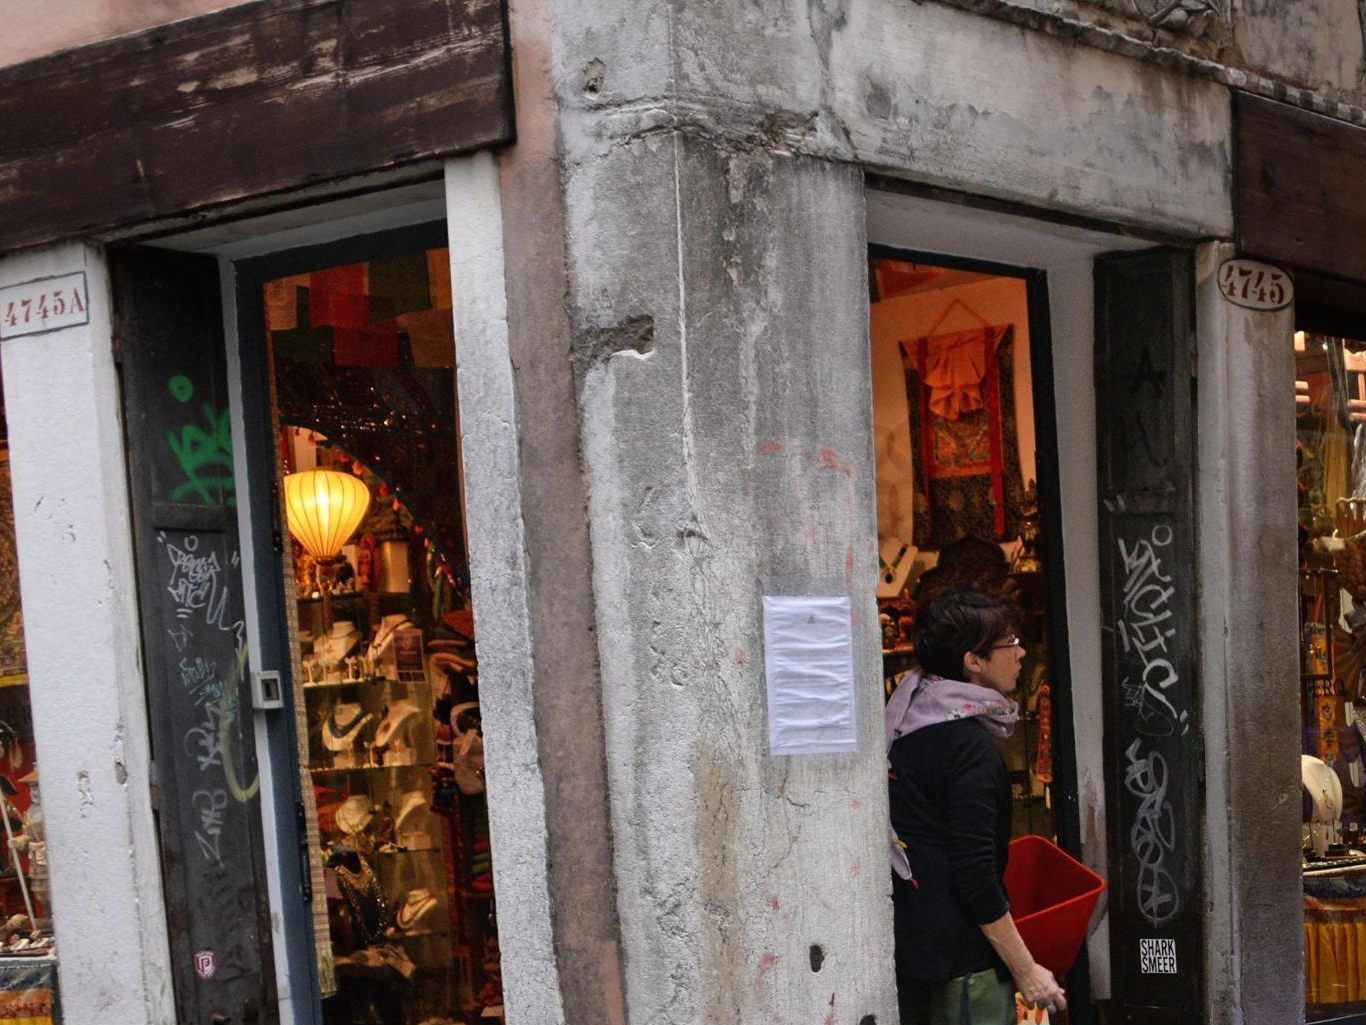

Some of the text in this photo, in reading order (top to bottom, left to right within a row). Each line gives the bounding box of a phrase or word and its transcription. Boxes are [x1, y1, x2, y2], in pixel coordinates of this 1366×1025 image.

[1221, 264, 1285, 305] 4745
[4, 287, 85, 327] 4745A
[1141, 939, 1175, 957] SHARK
[1142, 956, 1176, 973] SMEER
